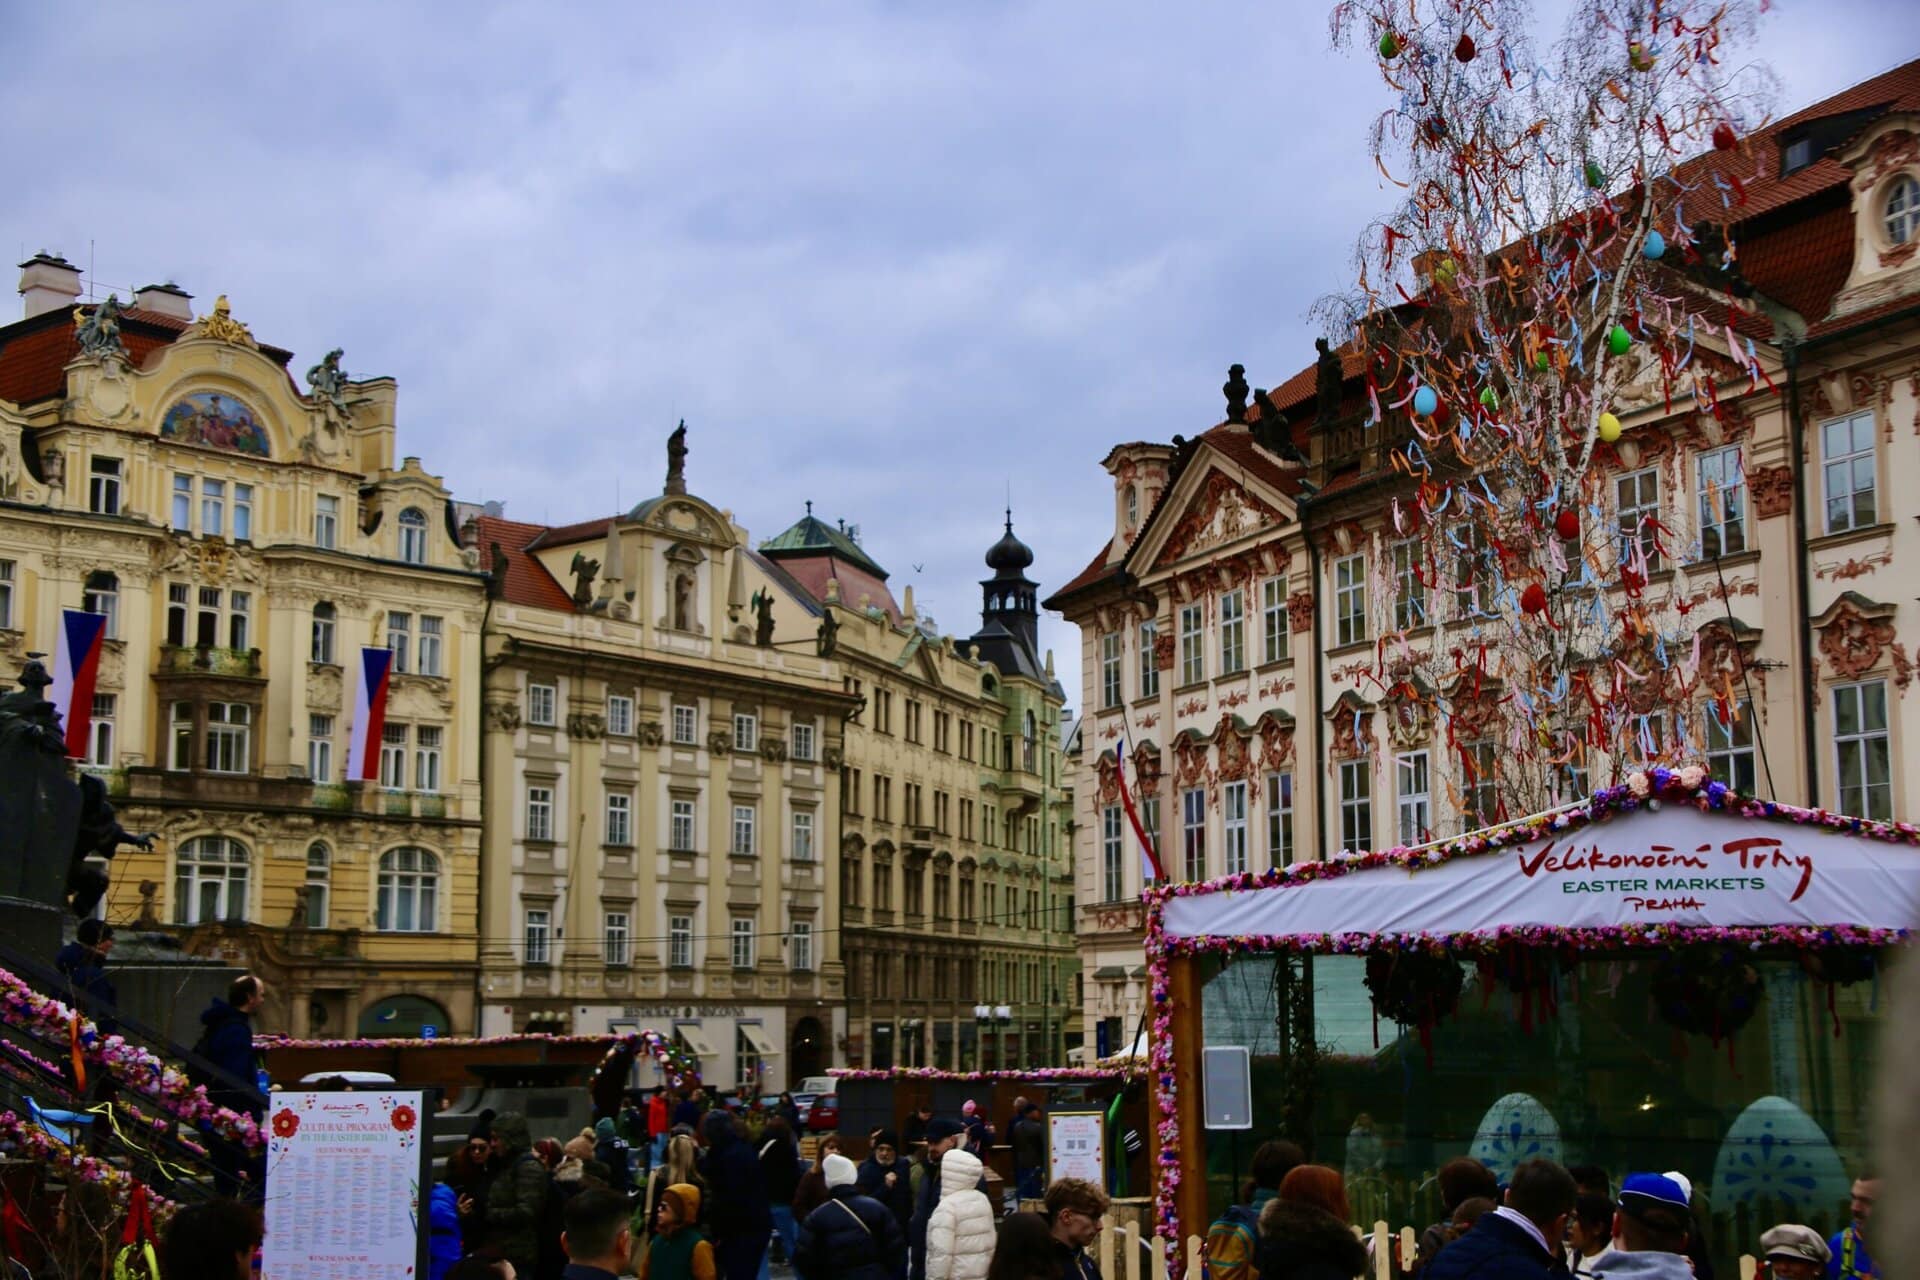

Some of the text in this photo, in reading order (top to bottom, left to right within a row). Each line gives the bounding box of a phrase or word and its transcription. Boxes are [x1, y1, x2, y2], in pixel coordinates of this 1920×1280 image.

[1517, 837, 1812, 902] Velikonoční Trhy
[1562, 878, 1765, 893] EASTER MARKETS
[1623, 896, 1706, 912] PRAHA
[346, 1123, 390, 1132] PROGRAM
